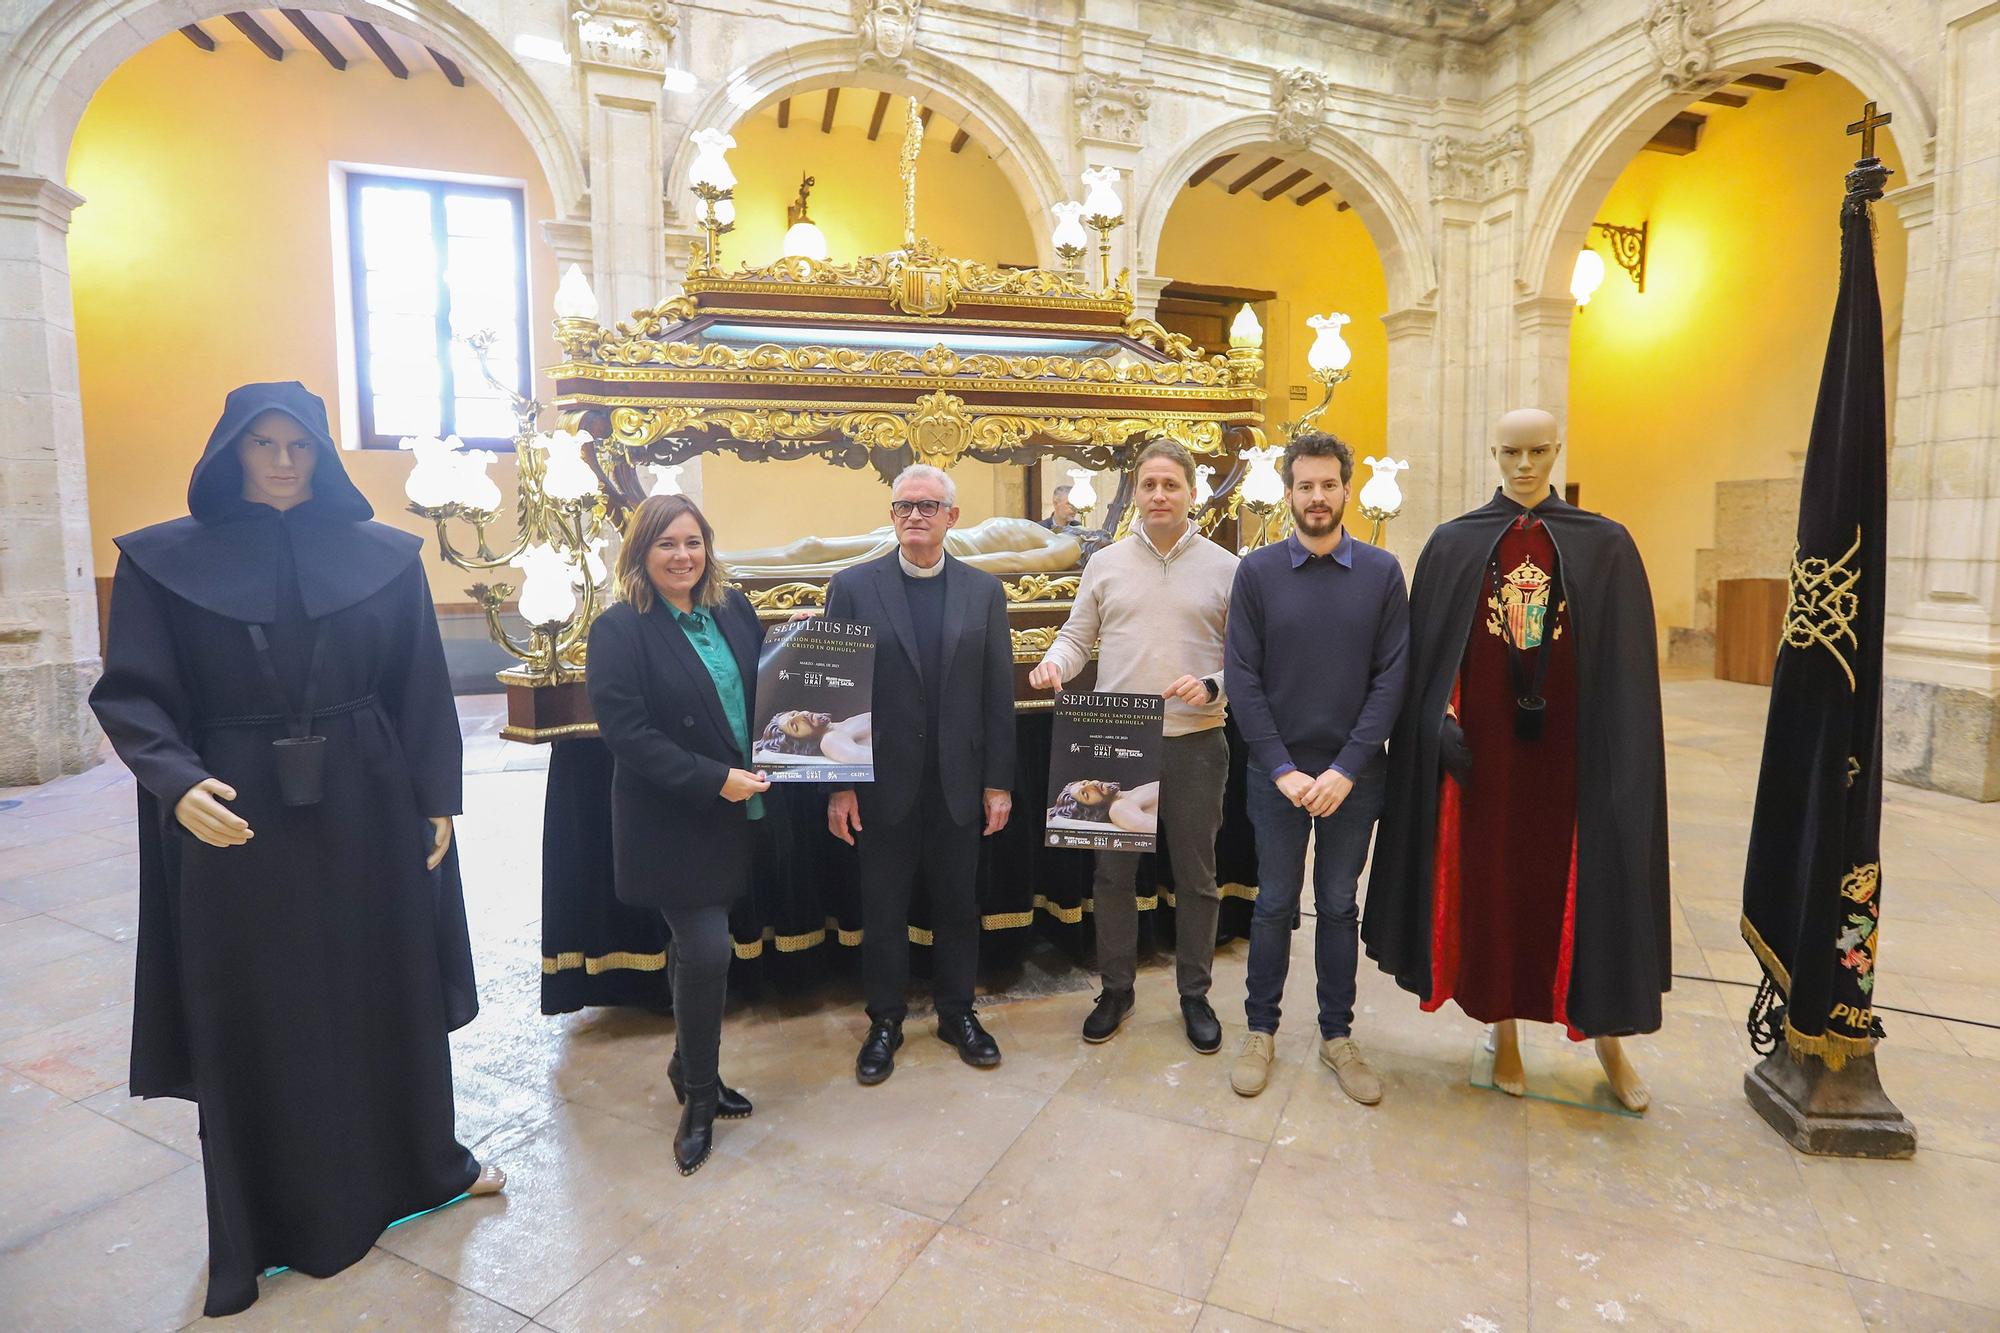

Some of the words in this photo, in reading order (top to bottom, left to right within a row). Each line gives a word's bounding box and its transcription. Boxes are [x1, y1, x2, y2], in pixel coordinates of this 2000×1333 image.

[773, 620, 841, 634] SEPULTUS
[845, 624, 871, 636] EST
[826, 645, 856, 653] ORIHUELA
[845, 641, 875, 649] ENTIERRO
[1062, 694, 1129, 708] SEPULTUS
[1134, 698, 1158, 709] EST
[1829, 1002, 1872, 1029] PRE
